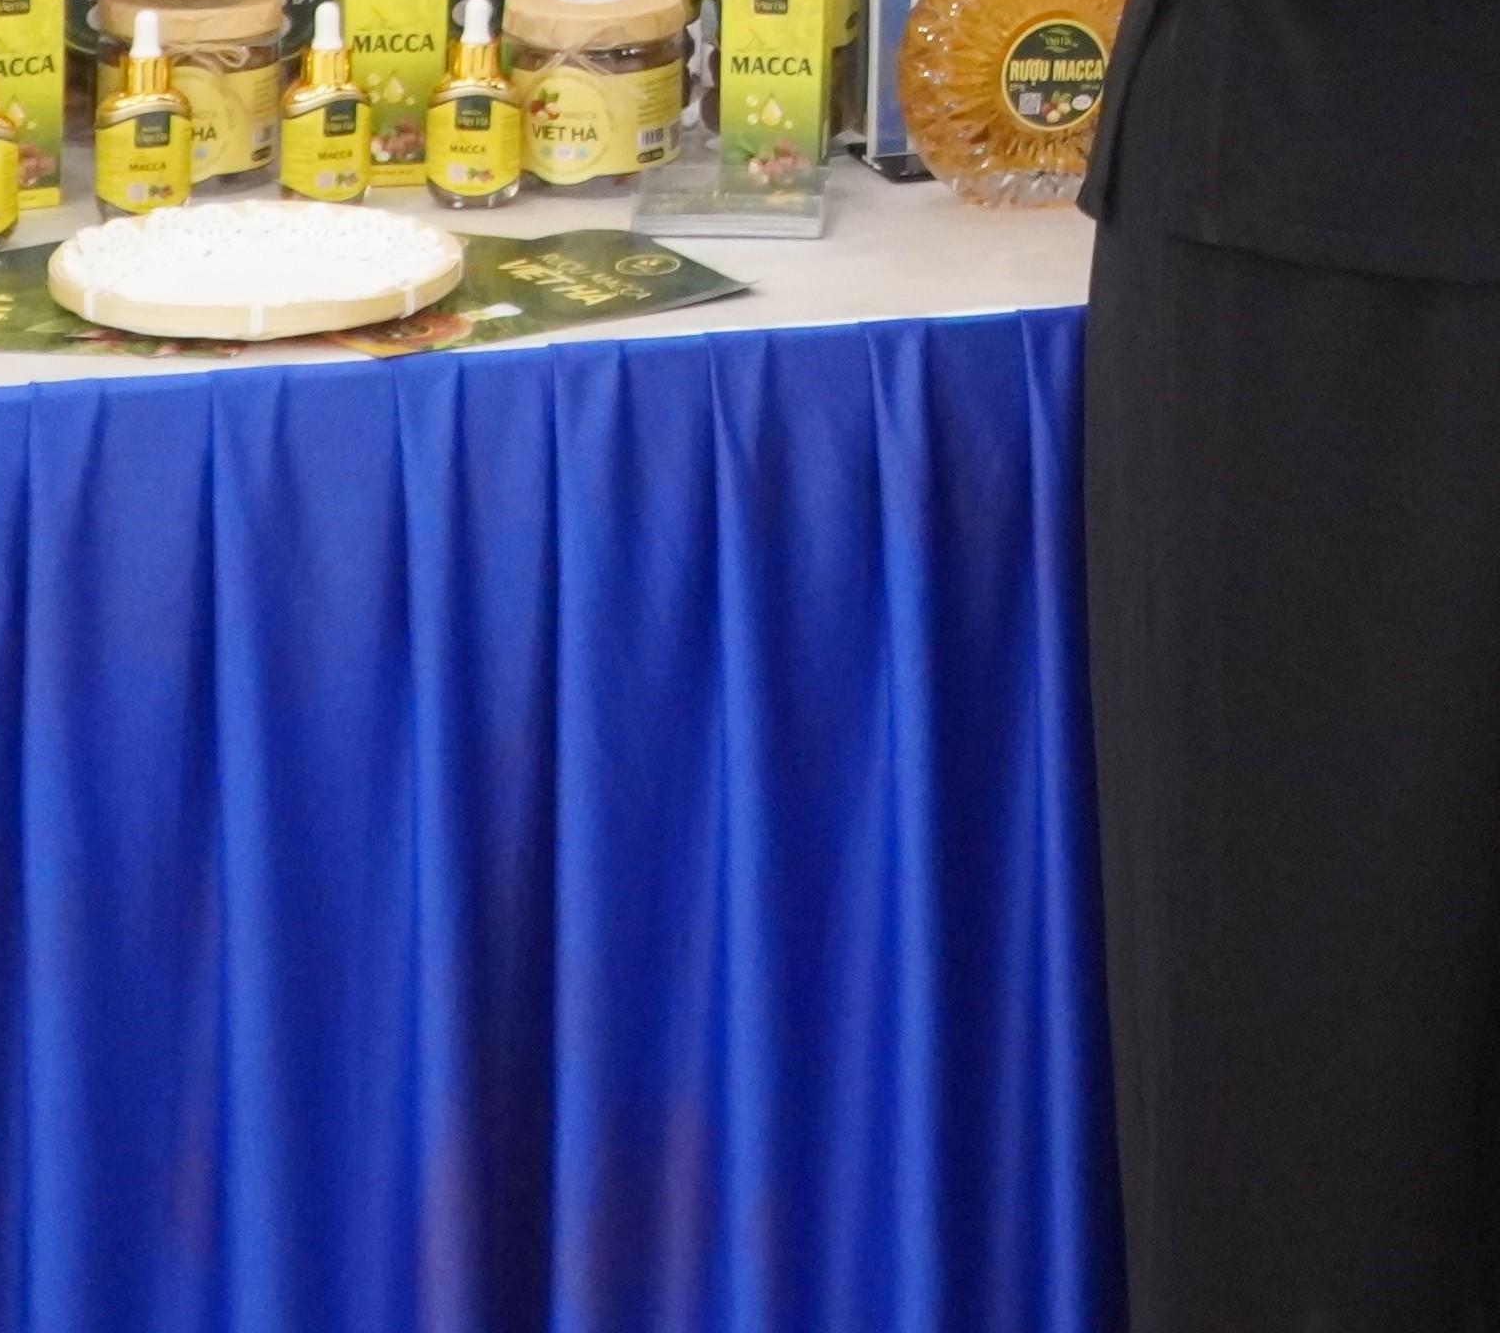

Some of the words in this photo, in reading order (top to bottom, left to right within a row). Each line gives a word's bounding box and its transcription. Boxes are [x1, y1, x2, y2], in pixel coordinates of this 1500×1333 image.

[351, 32, 435, 54] MACCA
[730, 56, 813, 76] MACCA
[1009, 58, 1050, 86] RƯỢU
[1052, 59, 1103, 81] MACCA
